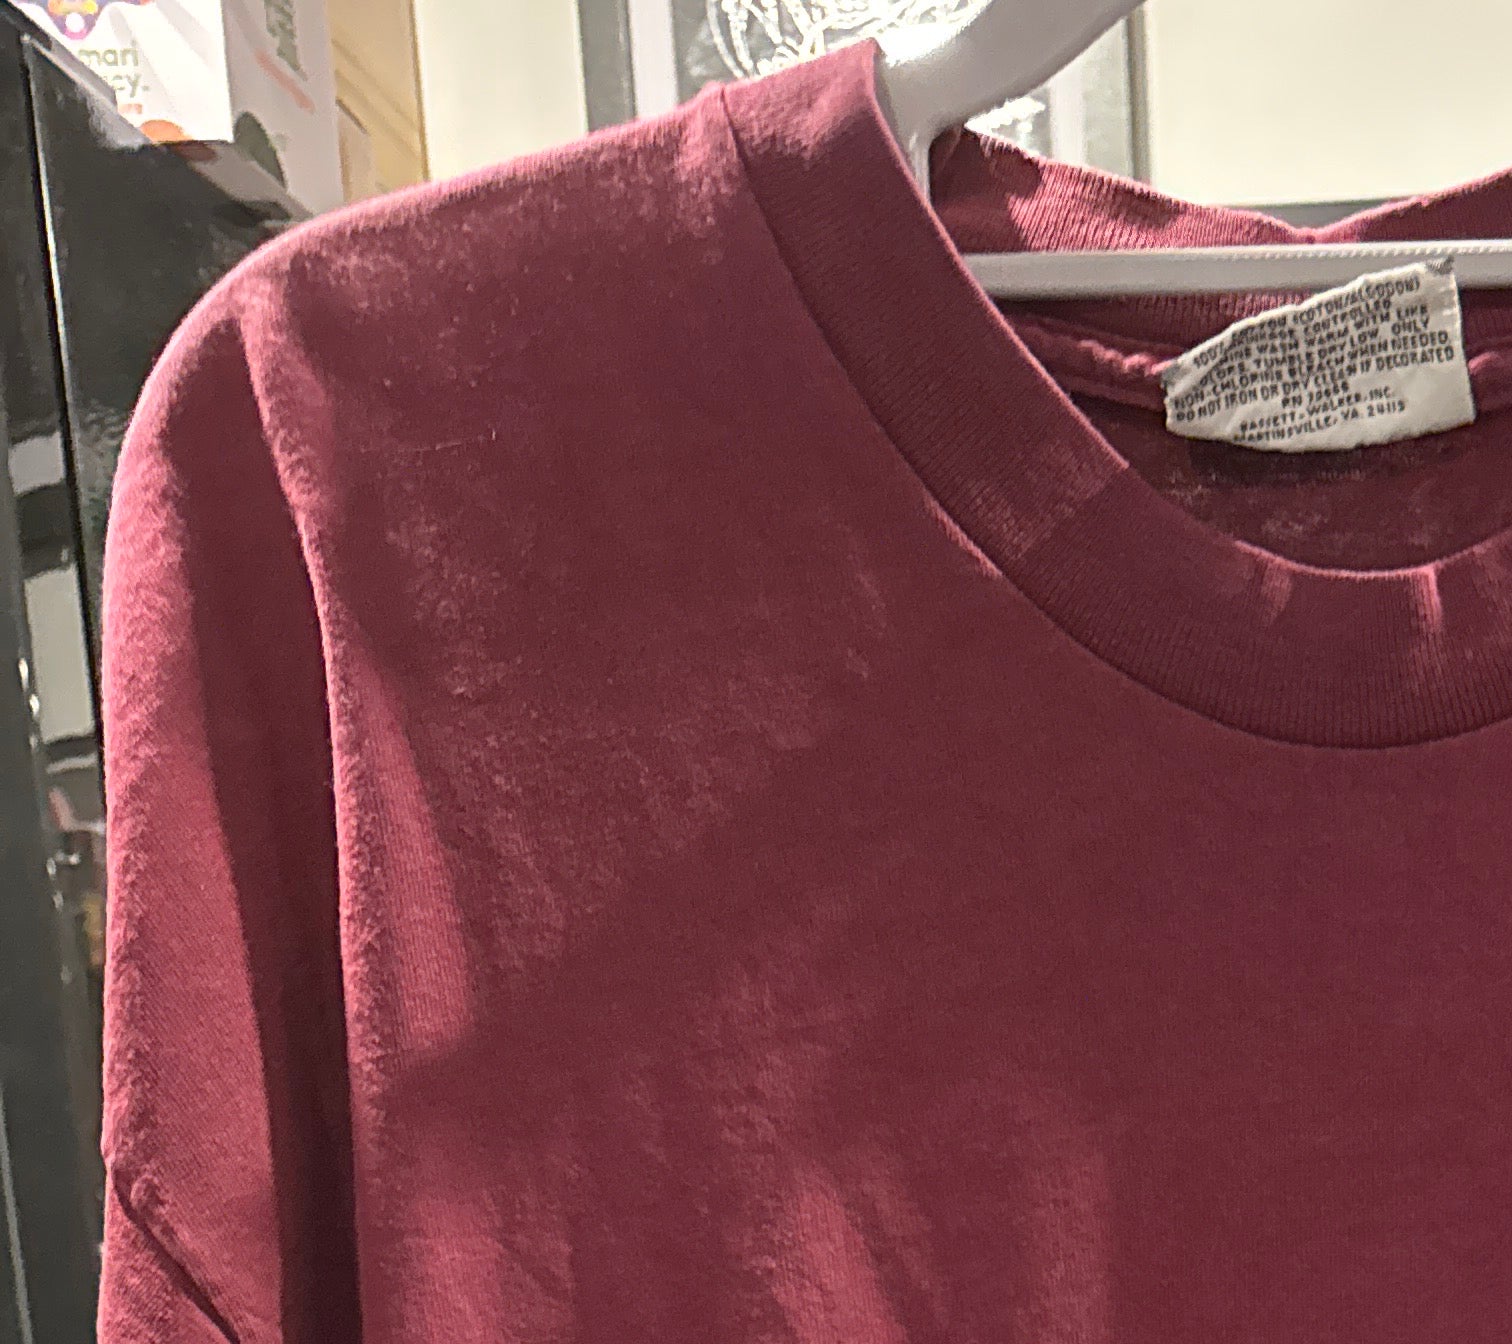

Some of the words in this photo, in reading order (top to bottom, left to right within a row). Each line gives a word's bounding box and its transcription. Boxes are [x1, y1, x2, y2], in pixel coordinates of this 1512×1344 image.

[1347, 339, 1388, 361] WHEN
[1198, 398, 1222, 418] NOT
[1224, 389, 1258, 410] IRON
[1260, 383, 1279, 402] OR
[1314, 364, 1358, 388] CLEAN
[1360, 358, 1372, 374] IF
[1376, 345, 1455, 373] DECORATED
